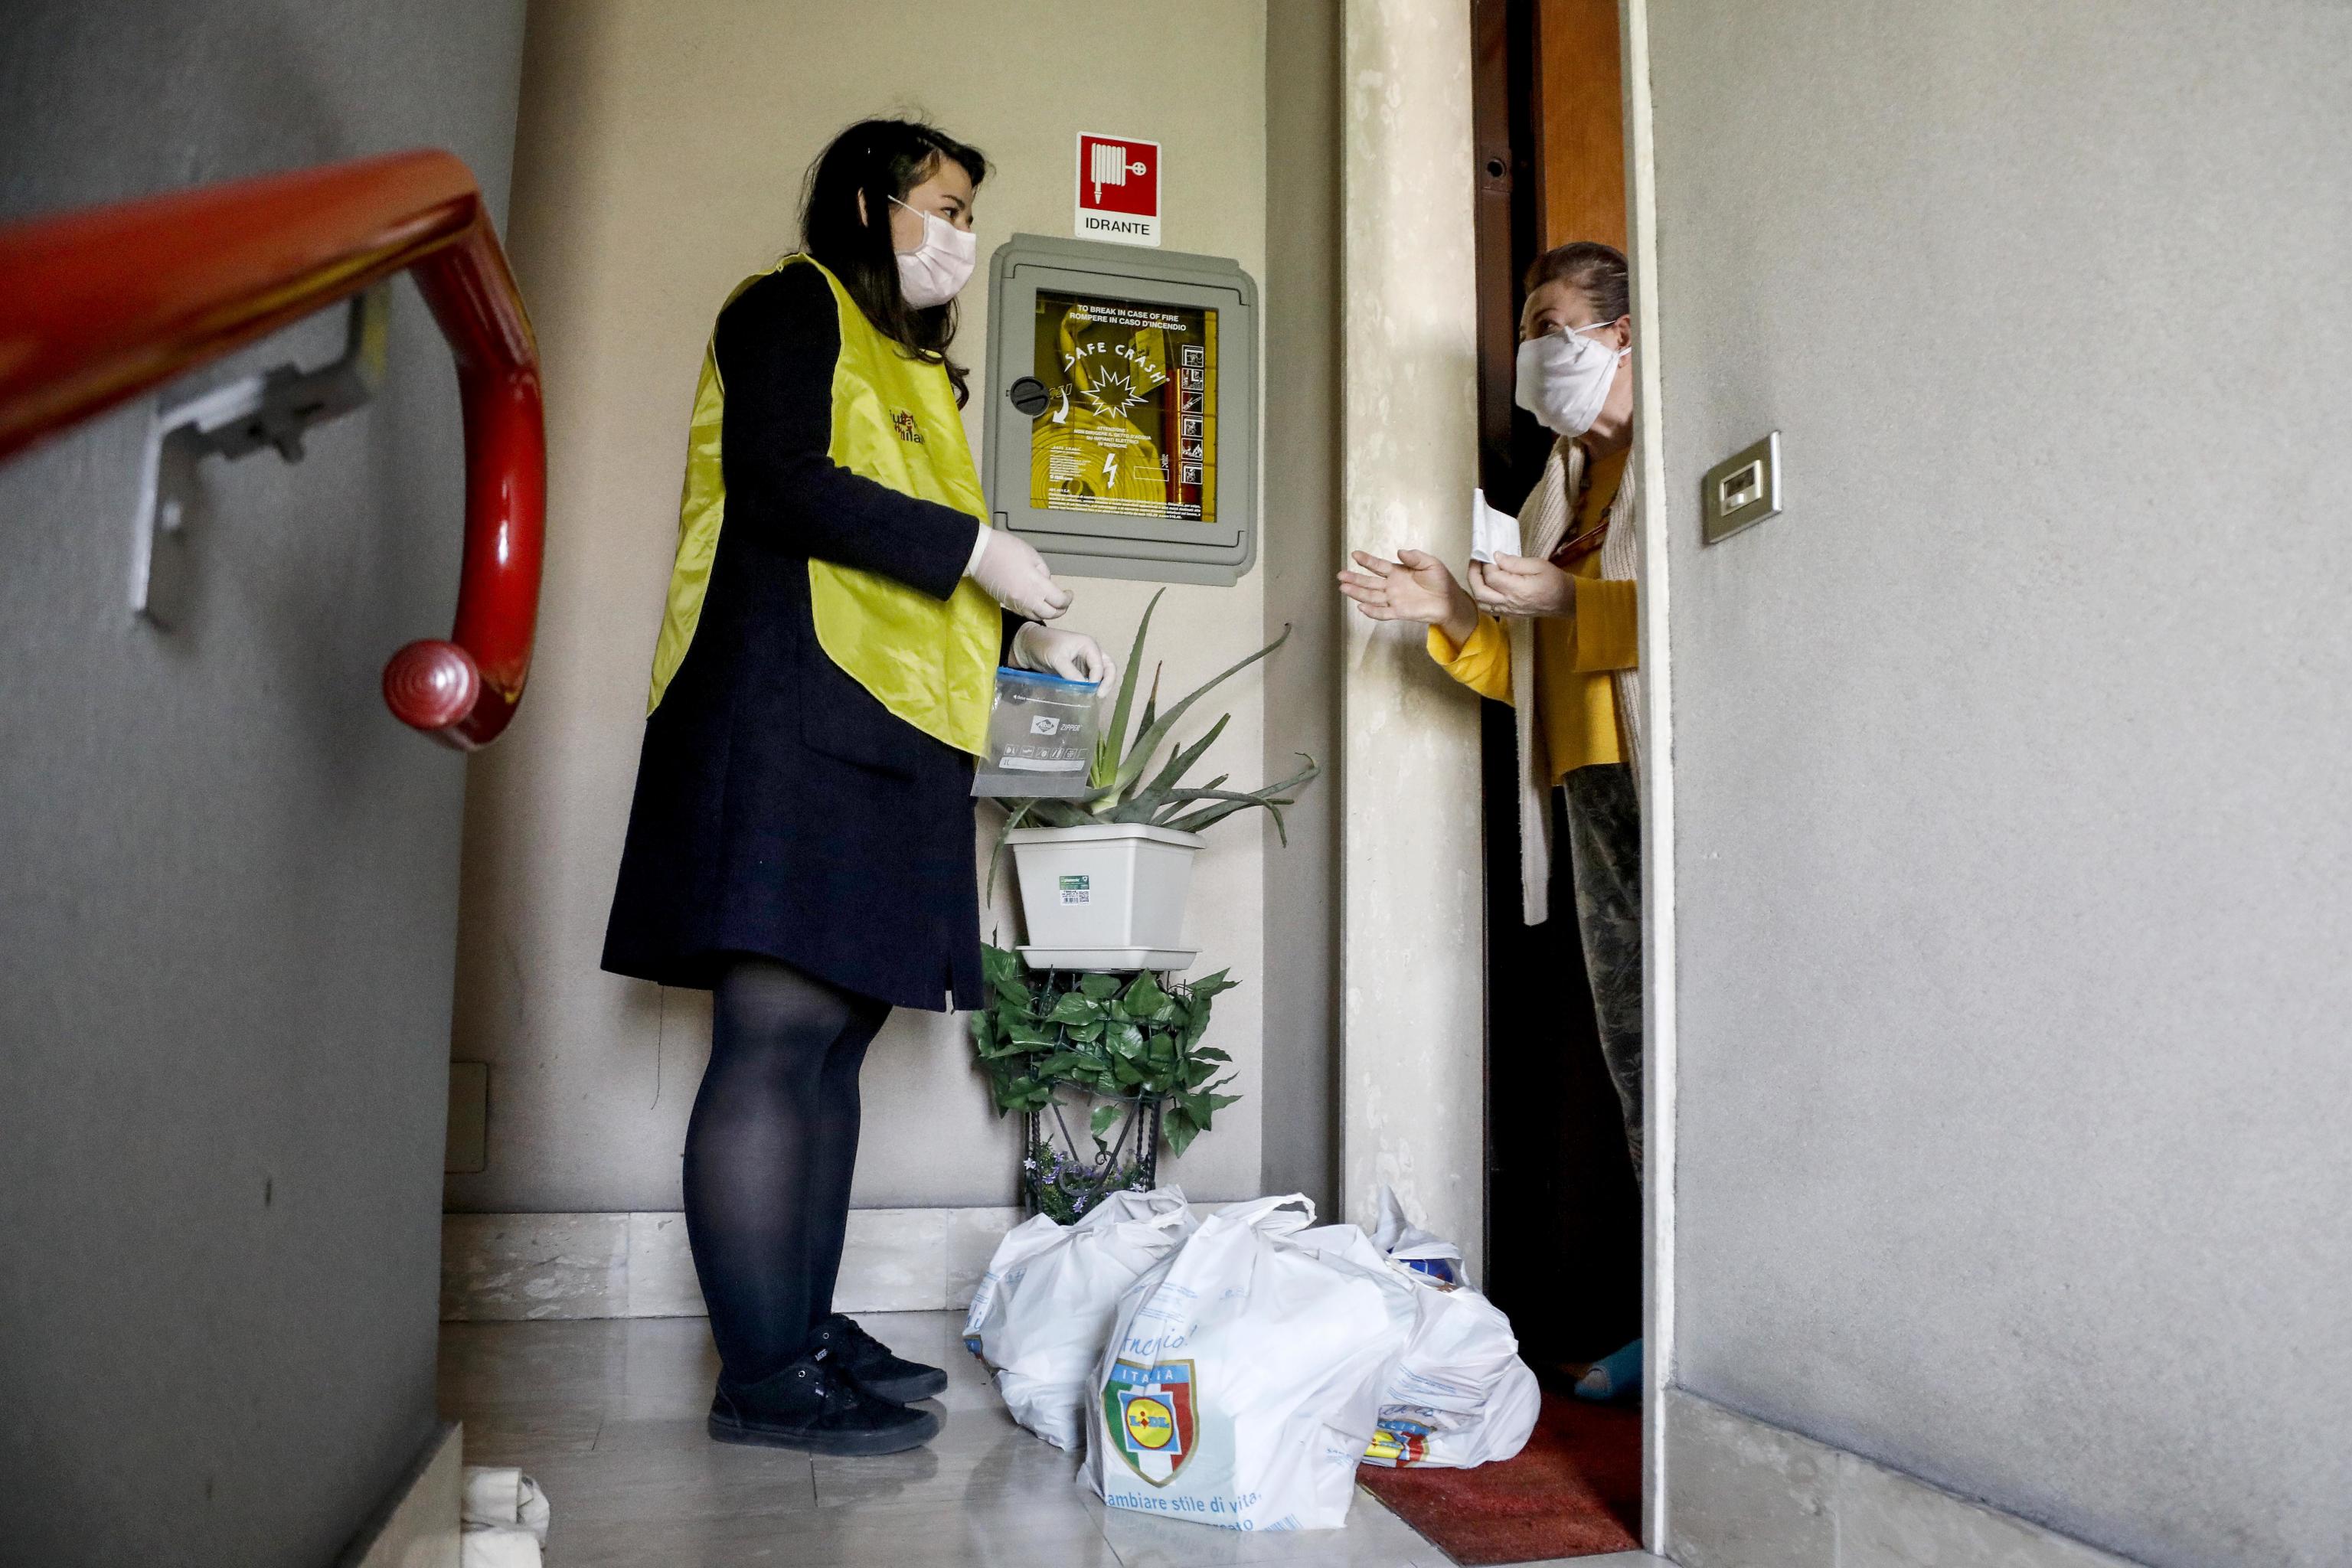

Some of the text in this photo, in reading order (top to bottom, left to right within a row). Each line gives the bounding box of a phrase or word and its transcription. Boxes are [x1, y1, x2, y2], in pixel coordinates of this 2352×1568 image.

[1086, 217, 1150, 236] IDRANTE
[1070, 312, 1107, 322] ROMPERE
[1119, 318, 1141, 326] CASO
[1142, 320, 1187, 332] D'INCENDIO
[1090, 306, 1116, 315] BREAK
[1127, 310, 1148, 318] CASE
[1161, 314, 1179, 322] FIRE
[1063, 342, 1166, 384] SAFE CRASH
[1122, 1369, 1173, 1383] ITAIA
[1107, 1491, 1167, 1510] ambiare
[1172, 1496, 1205, 1513] stile
[1210, 1496, 1224, 1513] di
